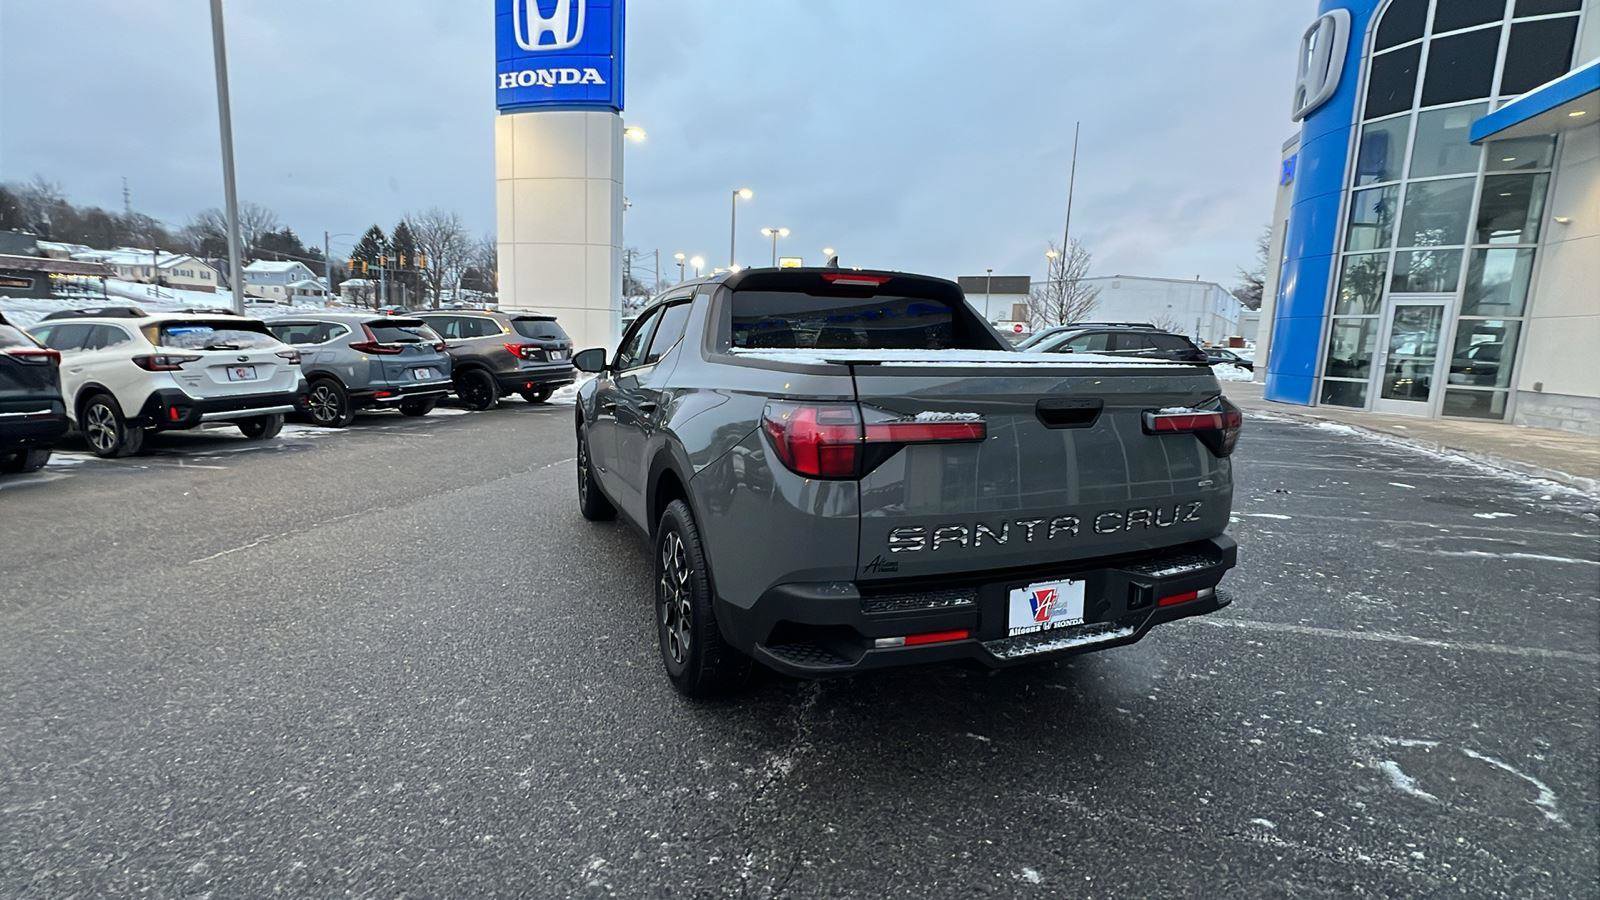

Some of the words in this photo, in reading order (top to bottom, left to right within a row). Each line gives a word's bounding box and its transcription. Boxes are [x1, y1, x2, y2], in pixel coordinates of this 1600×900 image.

[499, 68, 606, 89] HONDA
[888, 515, 1081, 553] SANTA
[1094, 501, 1203, 535] CRUZ
[1053, 618, 1085, 629] HONDA
